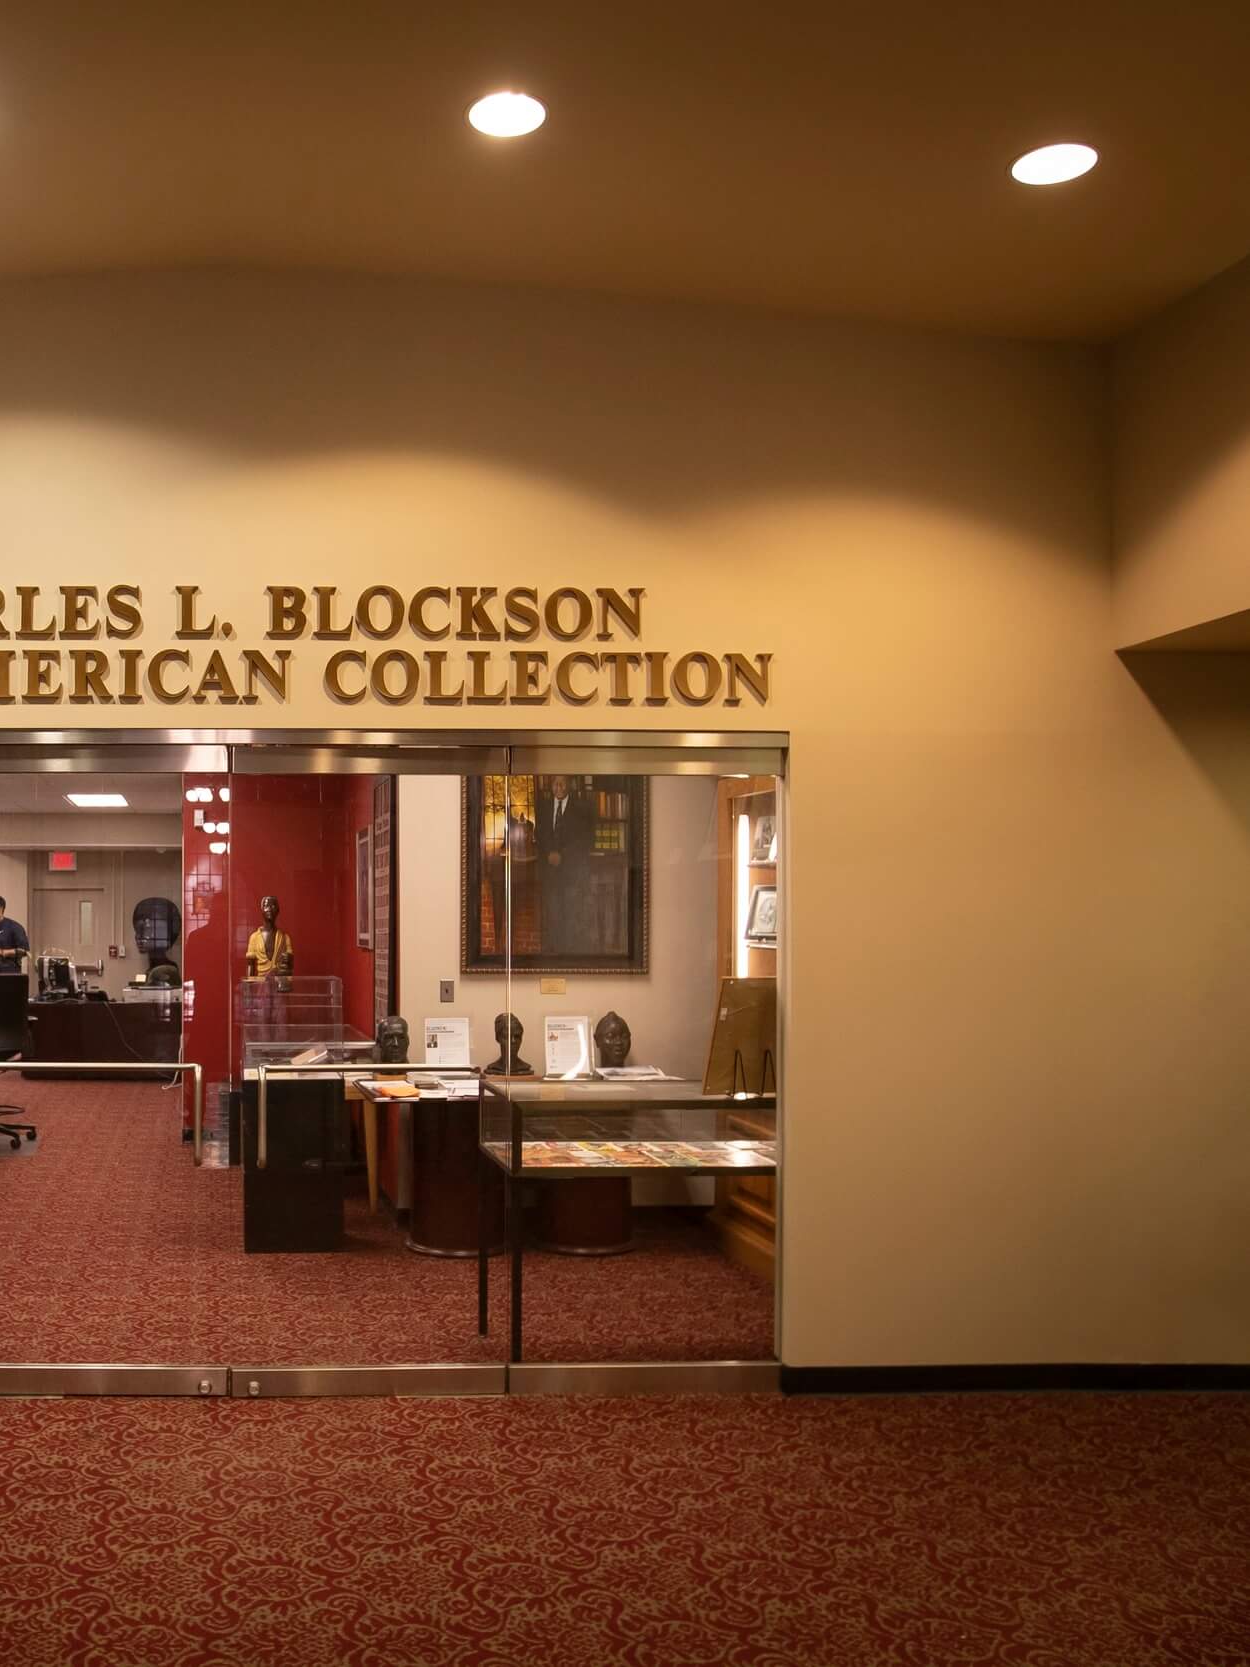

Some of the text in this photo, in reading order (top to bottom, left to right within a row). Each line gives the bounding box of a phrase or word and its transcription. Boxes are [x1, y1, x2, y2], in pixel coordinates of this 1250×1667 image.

[172, 586, 234, 640] L.
[264, 585, 646, 641] BLOCKSON
[324, 650, 773, 707] COLLECTION
